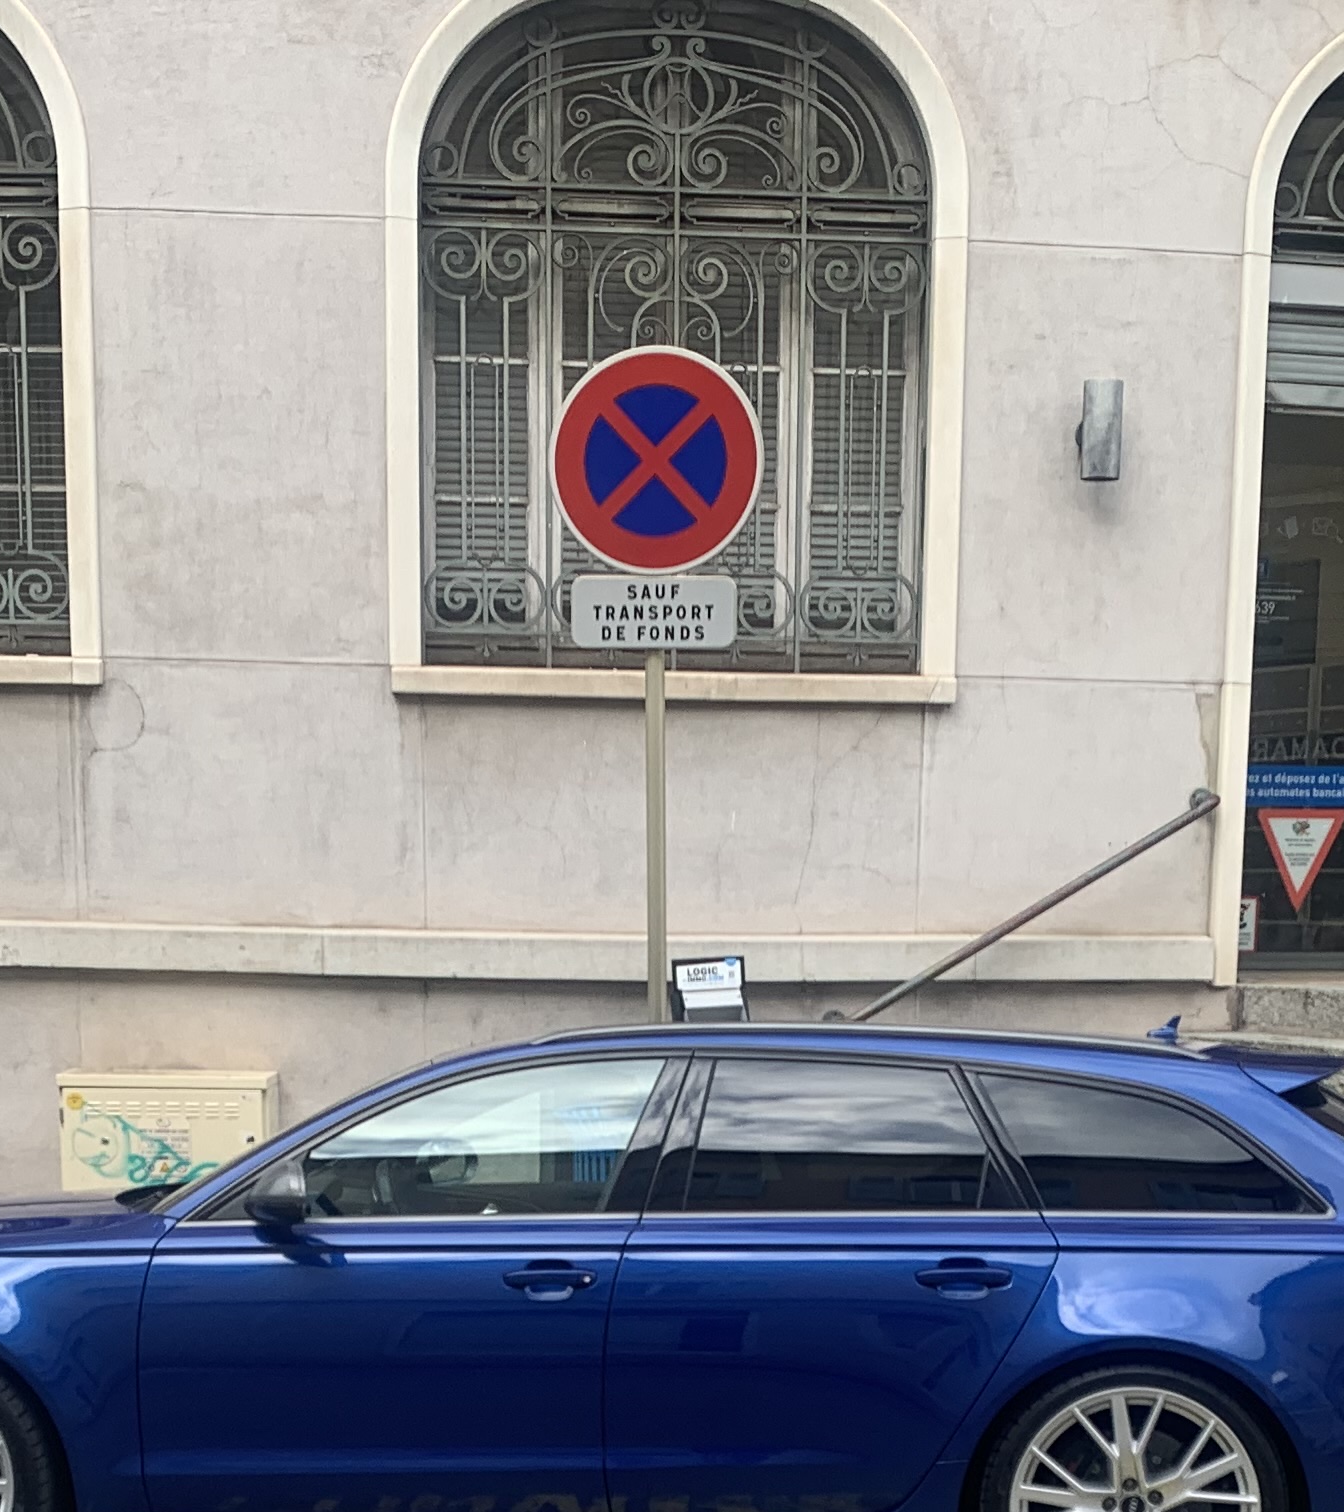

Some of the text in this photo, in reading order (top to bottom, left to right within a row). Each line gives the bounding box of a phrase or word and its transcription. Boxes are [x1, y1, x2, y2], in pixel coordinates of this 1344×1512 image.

[627, 584, 680, 599] SAUF
[593, 605, 714, 620] TRANSPORT
[602, 626, 704, 640] DE FONDS
[1275, 772, 1315, 785] déposez
[1318, 773, 1330, 784] de
[1258, 787, 1311, 797] automates
[687, 966, 718, 976] LOGIC
